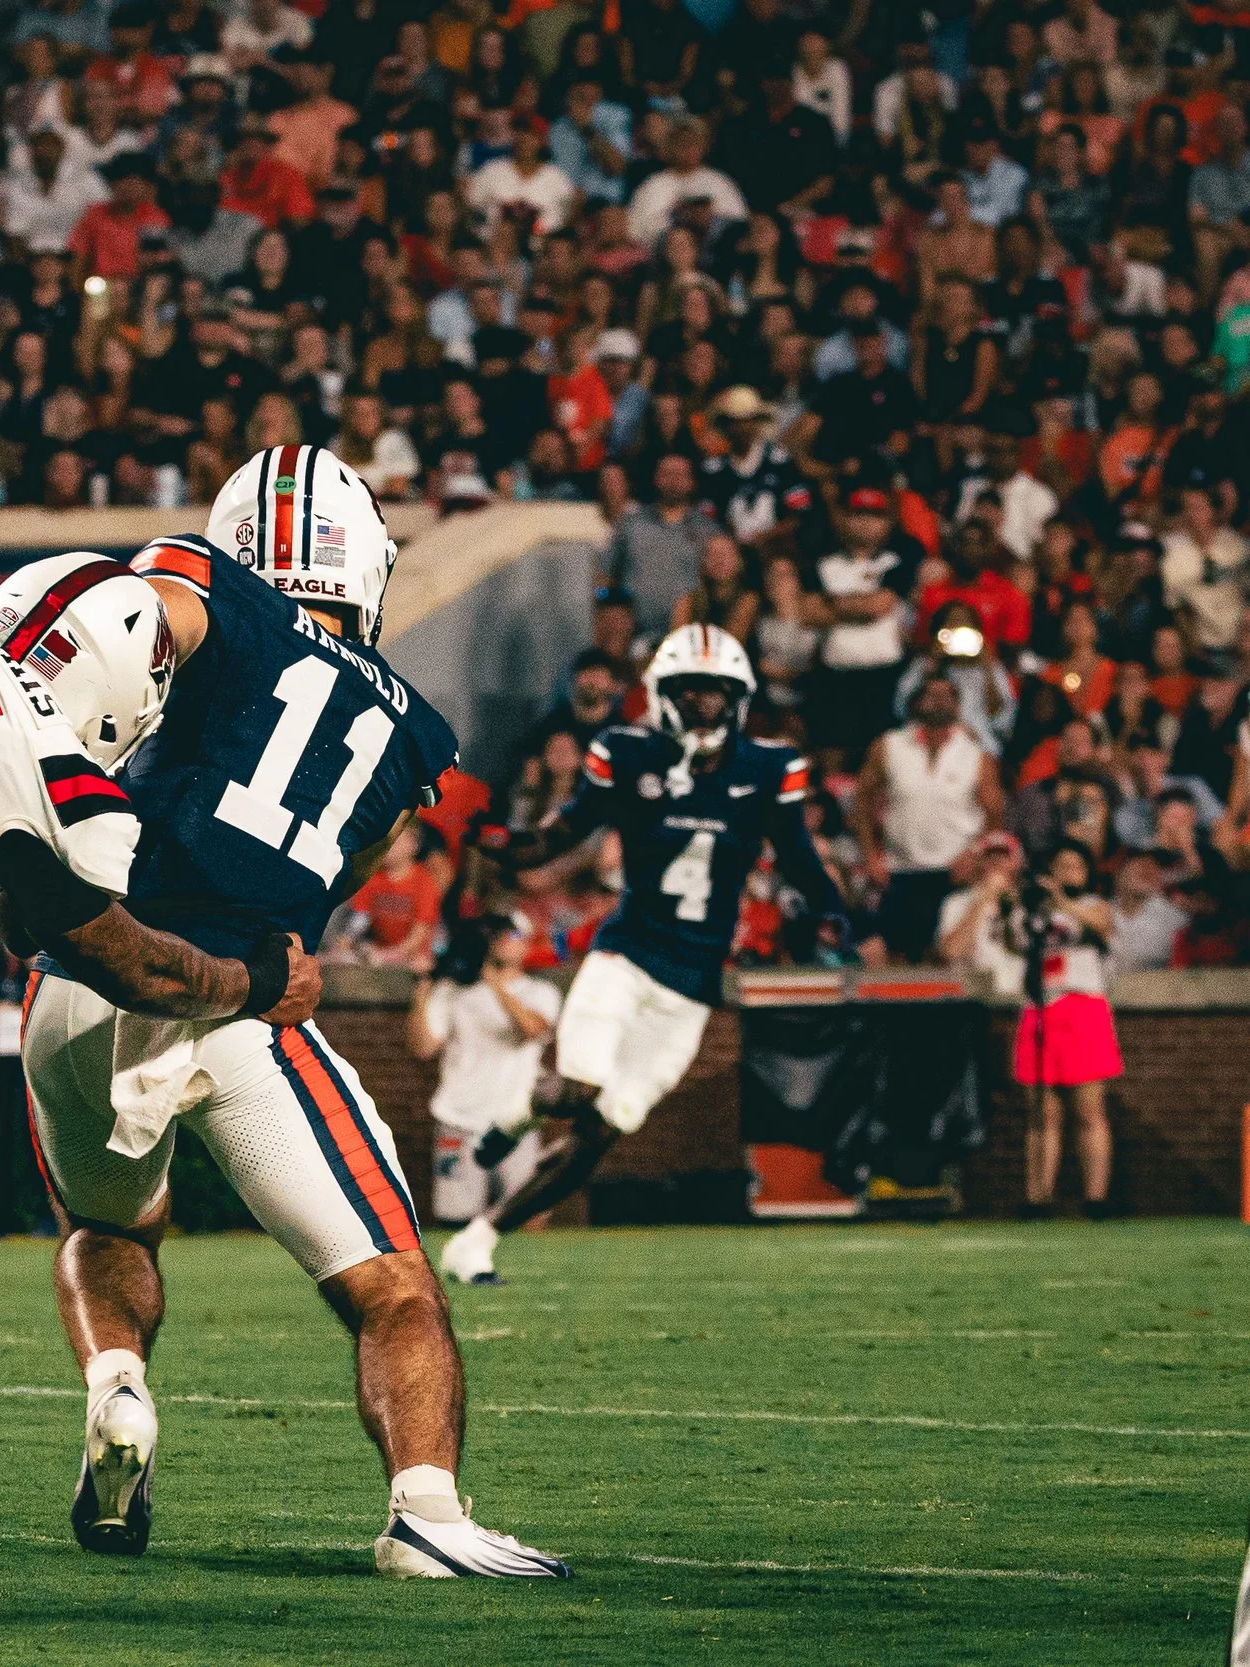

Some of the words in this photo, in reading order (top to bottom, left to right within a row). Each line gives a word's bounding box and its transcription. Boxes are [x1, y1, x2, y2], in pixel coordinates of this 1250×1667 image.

[275, 481, 295, 489] C2P
[236, 523, 254, 545] SEC
[274, 578, 346, 598] EAGLE
[213, 654, 395, 891] 11
[660, 832, 716, 921] 4
